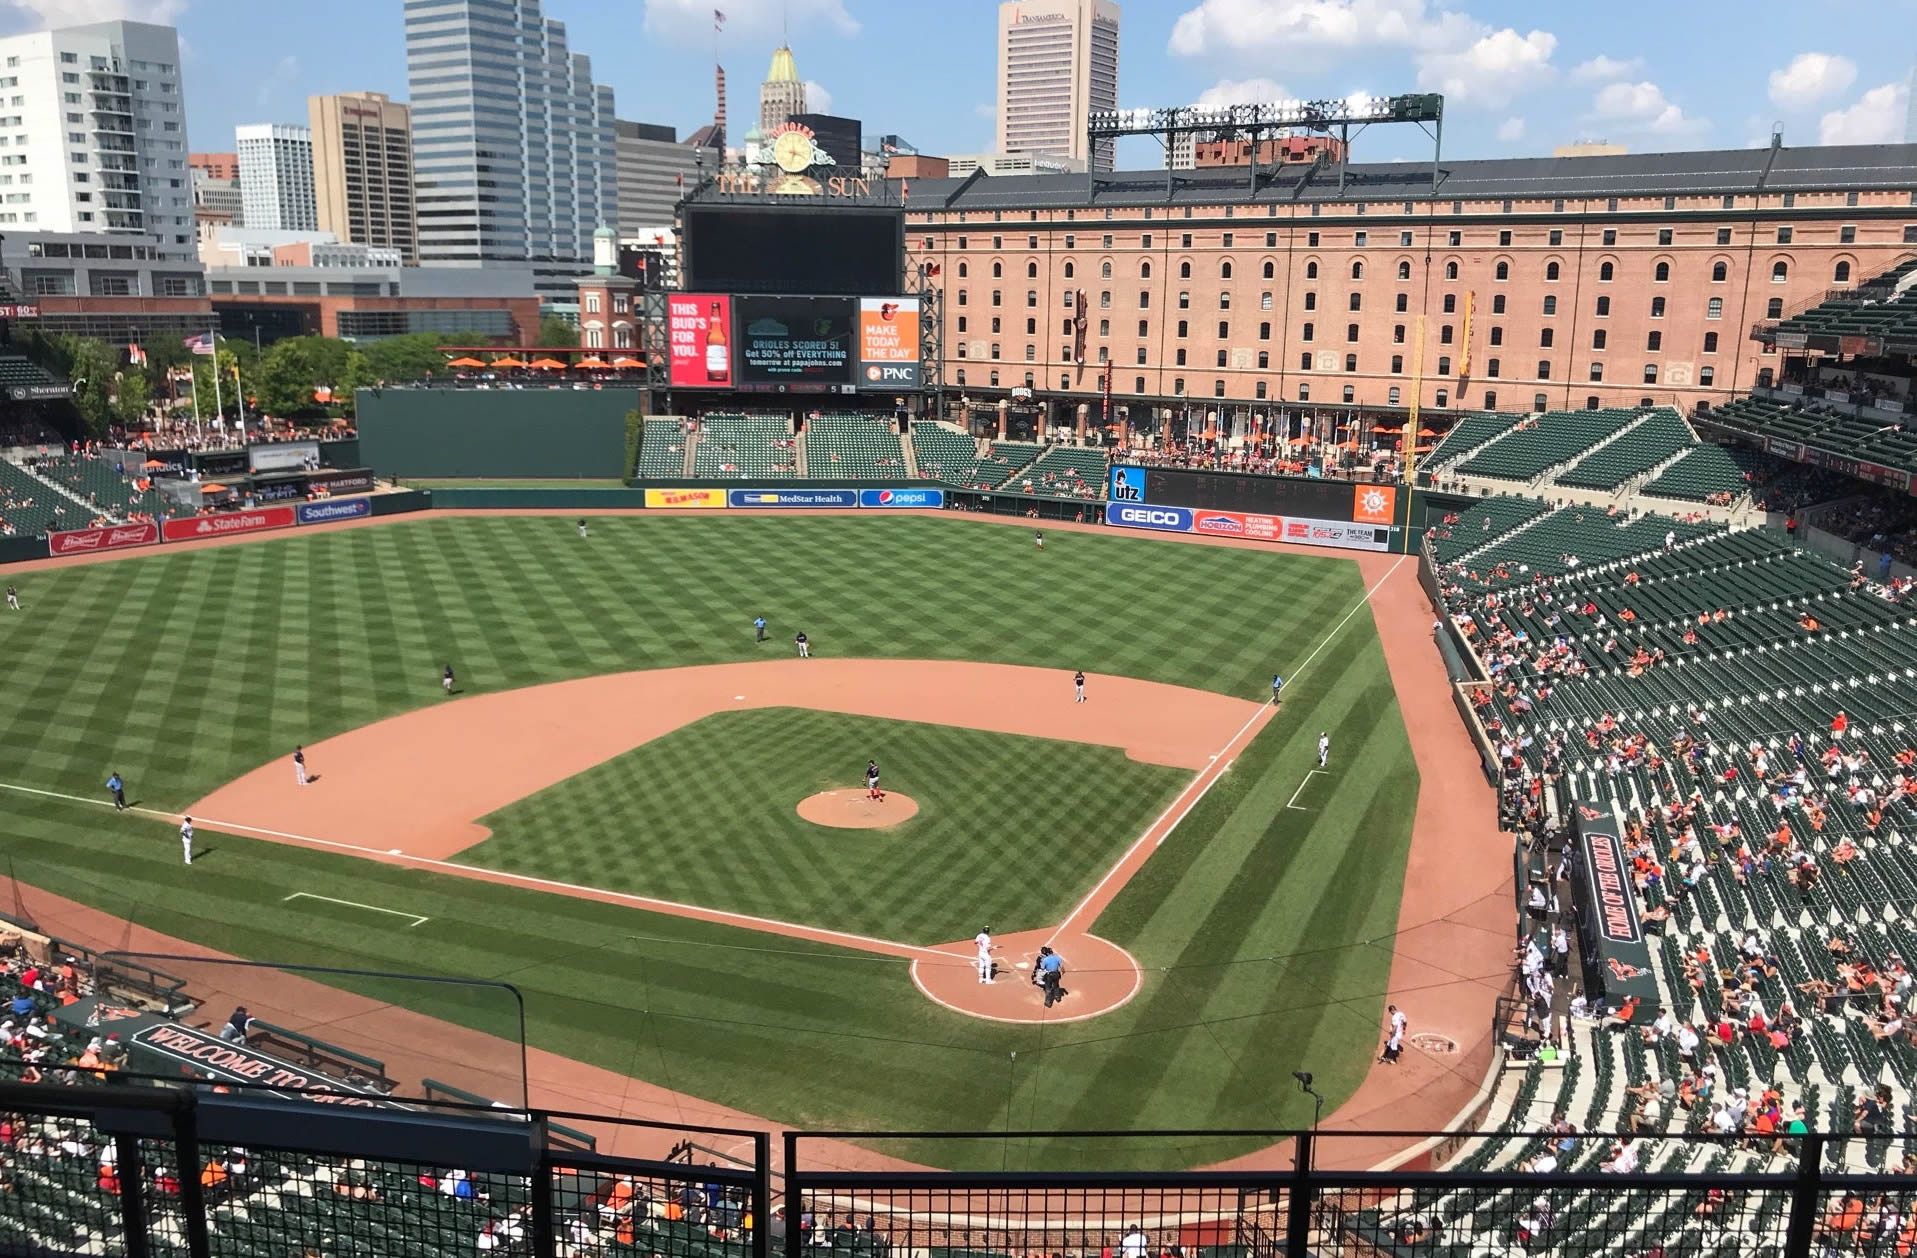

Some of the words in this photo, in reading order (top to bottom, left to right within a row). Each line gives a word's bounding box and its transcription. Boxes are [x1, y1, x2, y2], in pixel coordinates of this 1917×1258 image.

[771, 121, 815, 140] ORIOLES
[716, 175, 760, 194] THE
[828, 177, 870, 196] SUN
[672, 303, 698, 315] THIS
[672, 317, 706, 329] BUD'S
[865, 325, 897, 336] MAKE
[672, 331, 696, 343] FOR
[865, 336, 900, 348] TODAY
[672, 345, 699, 357] YOU.
[753, 341, 790, 349] ORIOLES
[792, 342, 827, 350] SCORED
[829, 342, 839, 350] 5!
[745, 350, 759, 358] Get
[761, 350, 780, 358] 50%
[783, 350, 794, 358] off
[796, 350, 847, 359] EVERYTHING
[865, 347, 888, 359] THE
[792, 359, 843, 368] papajohns.com
[883, 367, 913, 380] PNC
[30, 386, 69, 394] Sheraton
[330, 479, 367, 488] HARTFORD
[780, 495, 813, 503] MedStar
[814, 494, 842, 503] Health
[895, 493, 926, 504] pepsi
[1115, 486, 1139, 500] utz
[305, 503, 358, 519] Southwest
[1121, 508, 1179, 526] GEICO
[1200, 521, 1242, 531] HORIZON
[1245, 516, 1273, 525] HEATING
[1245, 523, 1278, 532] PLUMBING
[1245, 529, 1273, 537] COOLING
[1590, 836, 1618, 873] ORIOLES
[1597, 871, 1622, 892] THE
[1601, 889, 1625, 905] OF
[1604, 905, 1633, 939] HOME
[147, 1027, 275, 1079] WELCOME
[262, 1069, 308, 1089] TO
